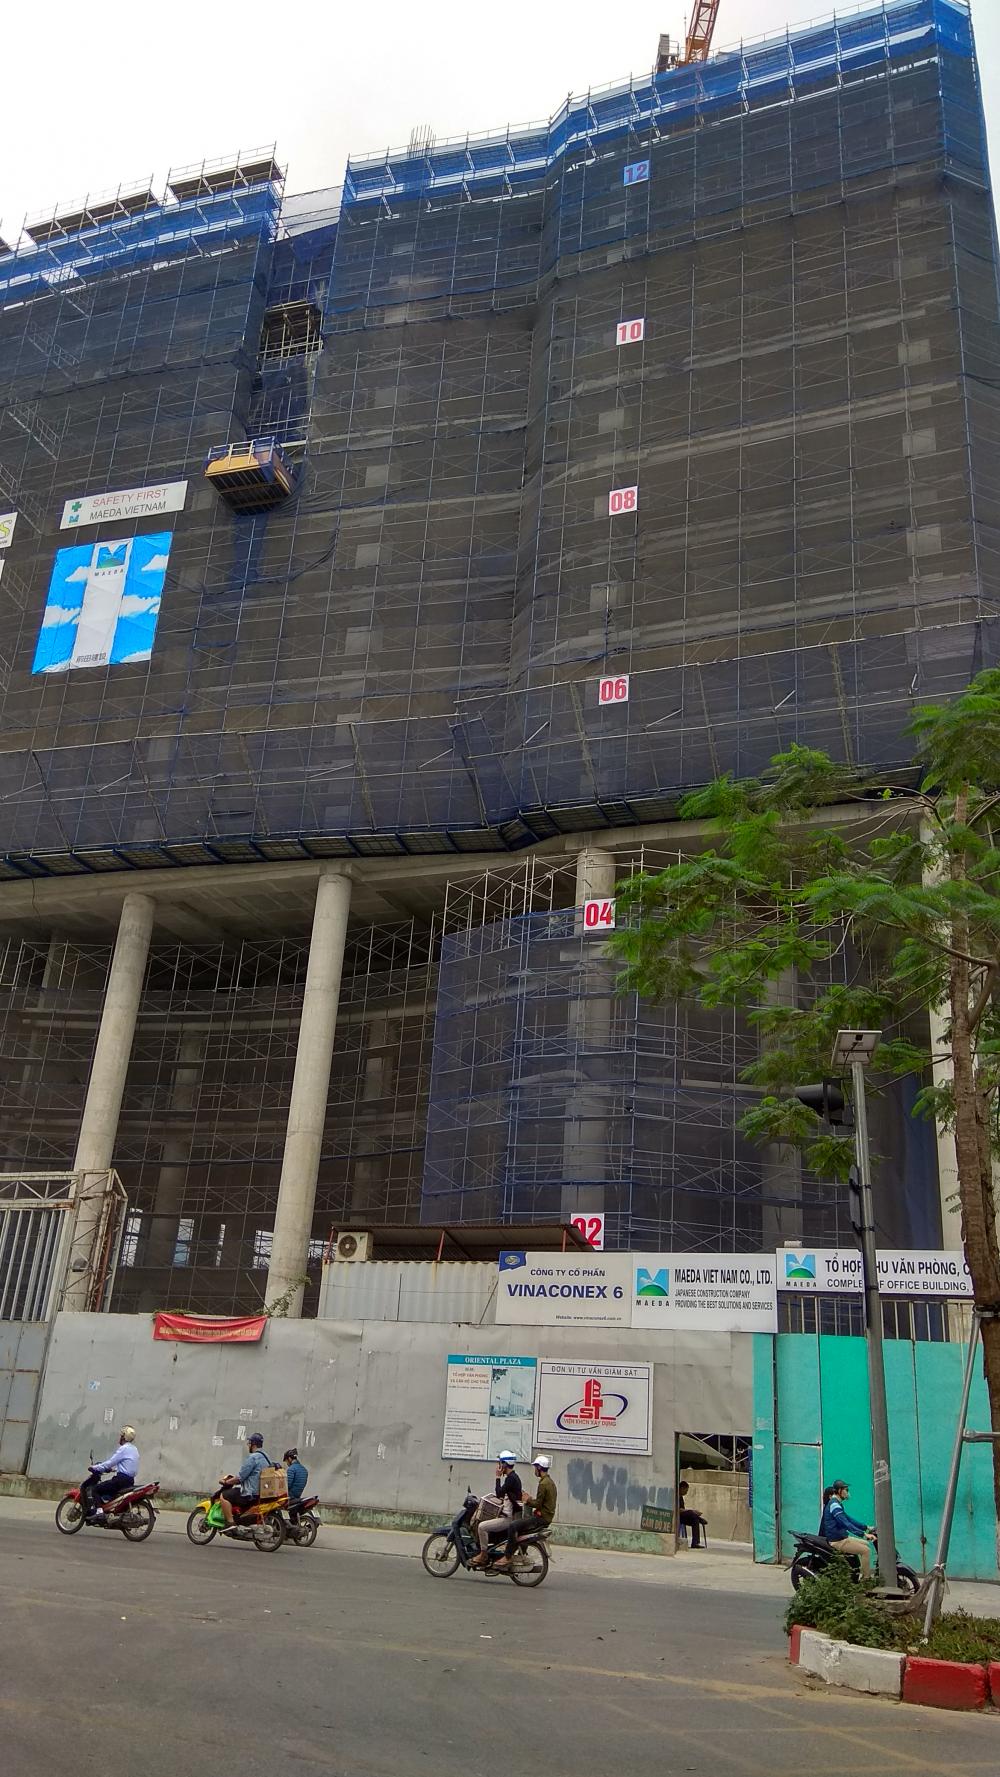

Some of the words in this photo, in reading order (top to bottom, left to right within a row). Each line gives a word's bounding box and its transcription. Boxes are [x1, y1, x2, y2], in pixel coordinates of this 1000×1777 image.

[625, 163, 647, 182] 12
[619, 321, 642, 341] 10
[92, 494, 134, 508] SAFETY
[137, 488, 168, 501] FIRST
[611, 489, 636, 512] 08
[90, 508, 122, 520] MAEDA
[125, 501, 167, 515] VIETNAM
[601, 679, 627, 701] 06
[586, 902, 612, 926] 04
[530, 1268, 554, 1276] CÔNG
[825, 1252, 839, 1273] TỔ
[892, 1258, 915, 1274] VĂN
[918, 1259, 960, 1276] PHÒNG,
[675, 1268, 701, 1283] MAEDA
[703, 1269, 719, 1283] VIET
[721, 1269, 738, 1284] NAM
[740, 1270, 755, 1286] CO.,
[757, 1270, 773, 1284] LTD.
[827, 1279, 863, 1288] COMPLE
[887, 1280, 920, 1289] OFFICE
[922, 1281, 970, 1292] BUILDING,
[507, 1284, 607, 1298] VINACONEX
[613, 1286, 623, 1299] 6
[675, 1289, 697, 1297] JAPANESE
[697, 1289, 729, 1298] CONSTRUCTION
[729, 1290, 750, 1298] COMPANY
[675, 1300, 698, 1308] PROVIDING
[698, 1300, 706, 1309] THE
[707, 1301, 718, 1309] BEST
[718, 1301, 742, 1309] SOLUTIONS
[742, 1302, 752, 1310] AND
[752, 1302, 773, 1310] SERVICES
